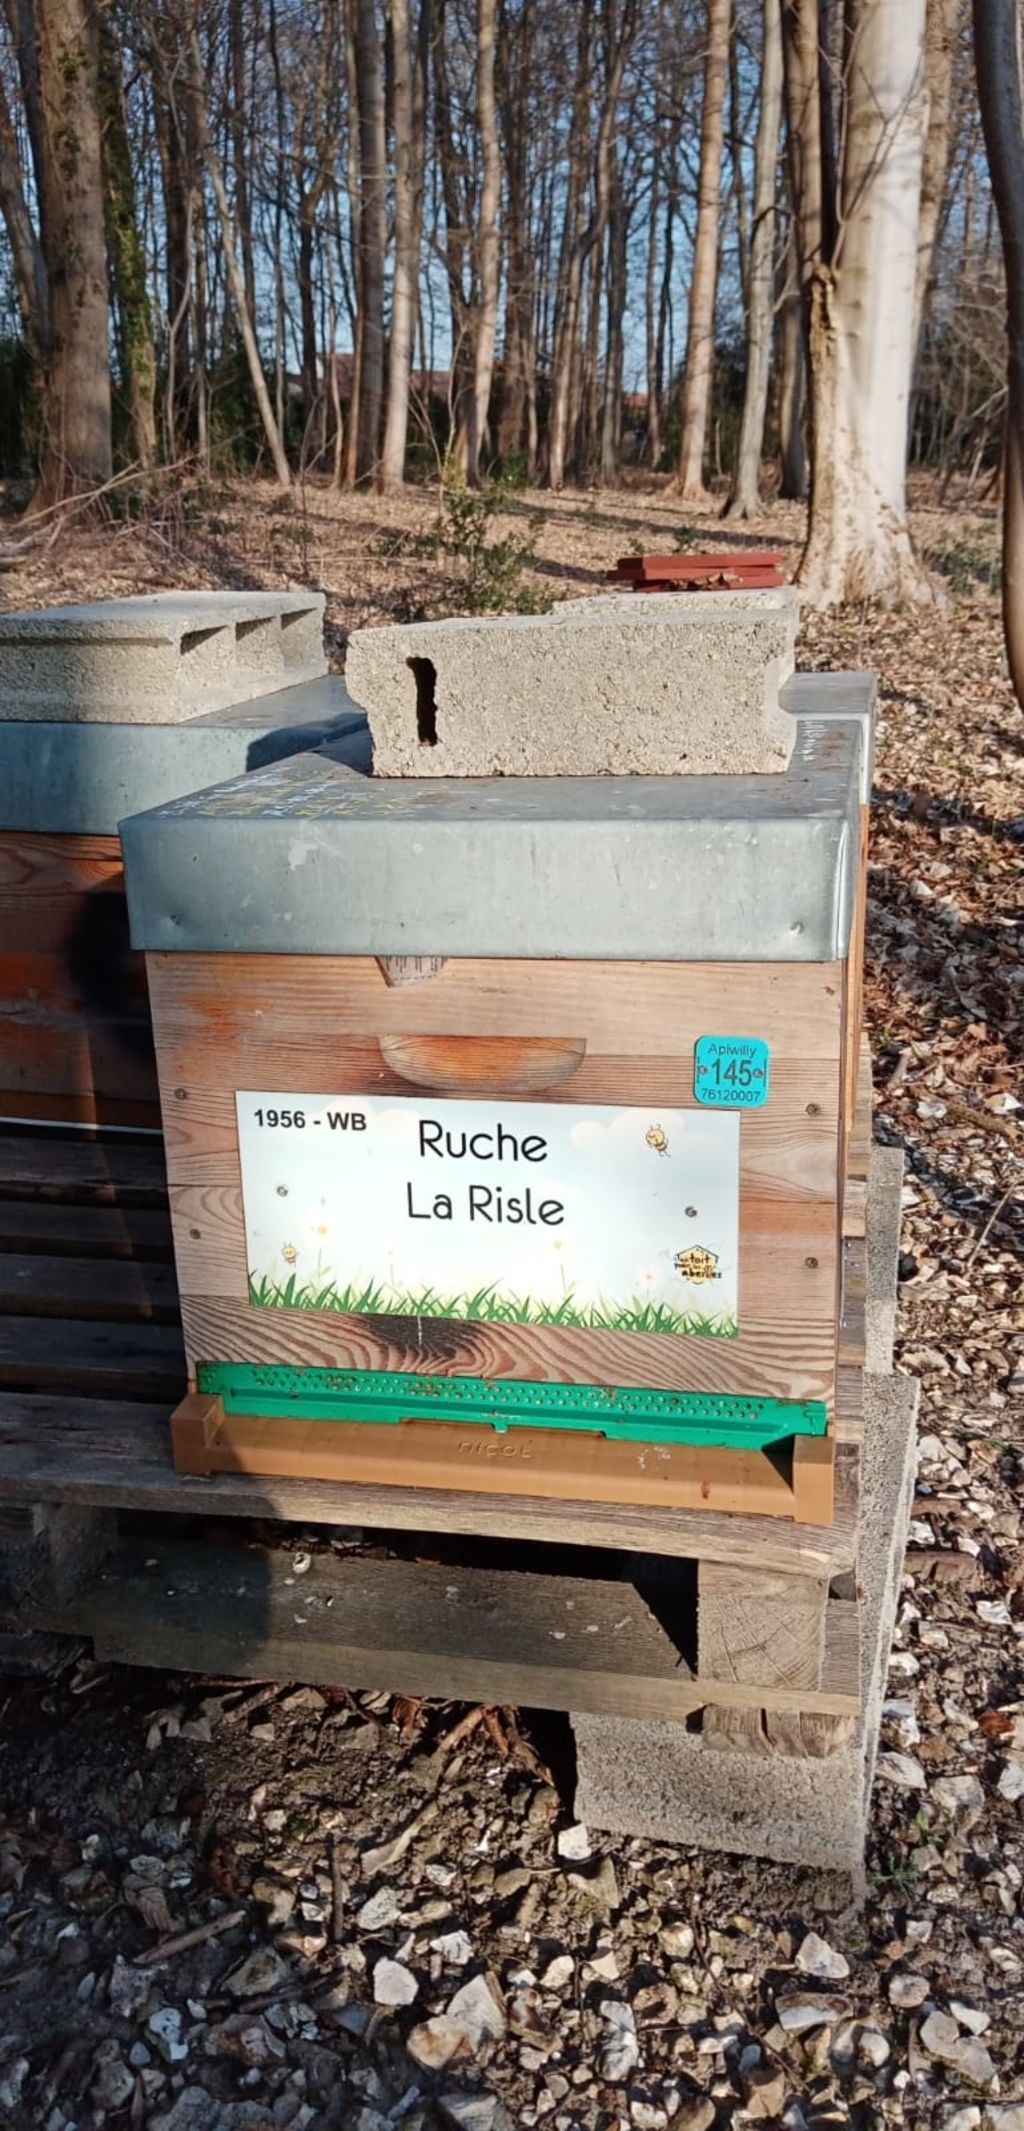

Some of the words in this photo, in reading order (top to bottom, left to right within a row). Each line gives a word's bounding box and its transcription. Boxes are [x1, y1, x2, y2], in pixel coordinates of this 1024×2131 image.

[708, 1043, 757, 1059] Apiwilly
[712, 1058, 753, 1086] 145
[702, 1088, 760, 1102] 76120007
[254, 1109, 306, 1129] 1956
[326, 1112, 367, 1131] WB
[419, 1119, 548, 1162] Ruche
[407, 1181, 453, 1220] La
[469, 1184, 565, 1226] Risle
